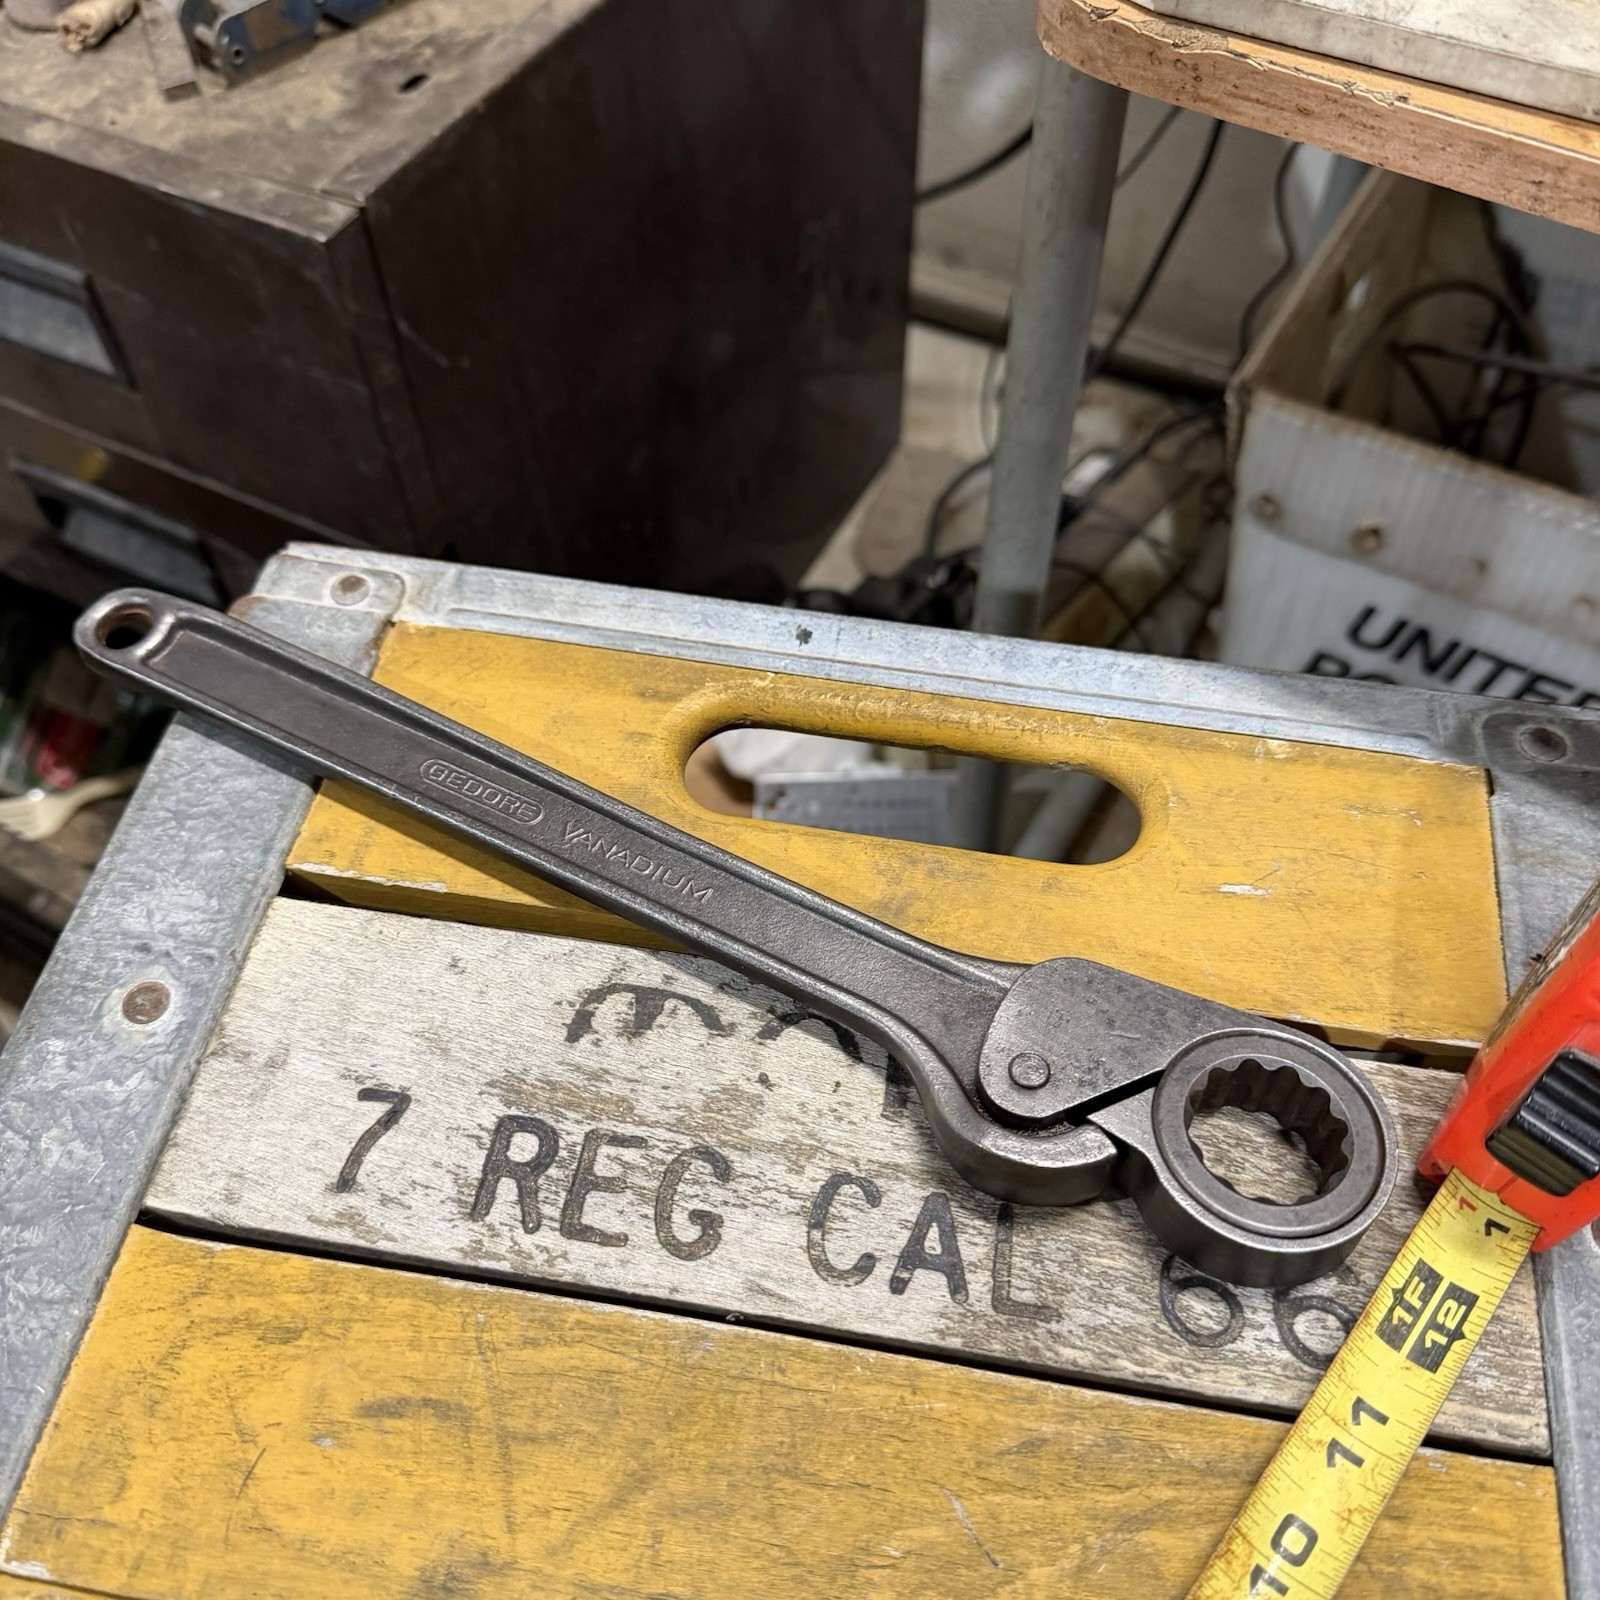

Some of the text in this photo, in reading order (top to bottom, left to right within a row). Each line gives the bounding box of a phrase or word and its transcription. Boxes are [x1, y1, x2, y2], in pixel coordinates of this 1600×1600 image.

[1346, 604, 1600, 706] UNITE
[428, 763, 538, 823] GEDORE
[562, 821, 713, 904] VANADIUM
[336, 1086, 412, 1193] 7
[471, 1113, 732, 1261] REG
[807, 1171, 1061, 1323] CAL
[1458, 1196, 1478, 1213] 1
[1484, 1217, 1511, 1237] 1
[1391, 1275, 1426, 1326] 1F
[1424, 1298, 1468, 1349] 12
[1326, 1396, 1390, 1469] 11
[1249, 1512, 1319, 1598] 10
